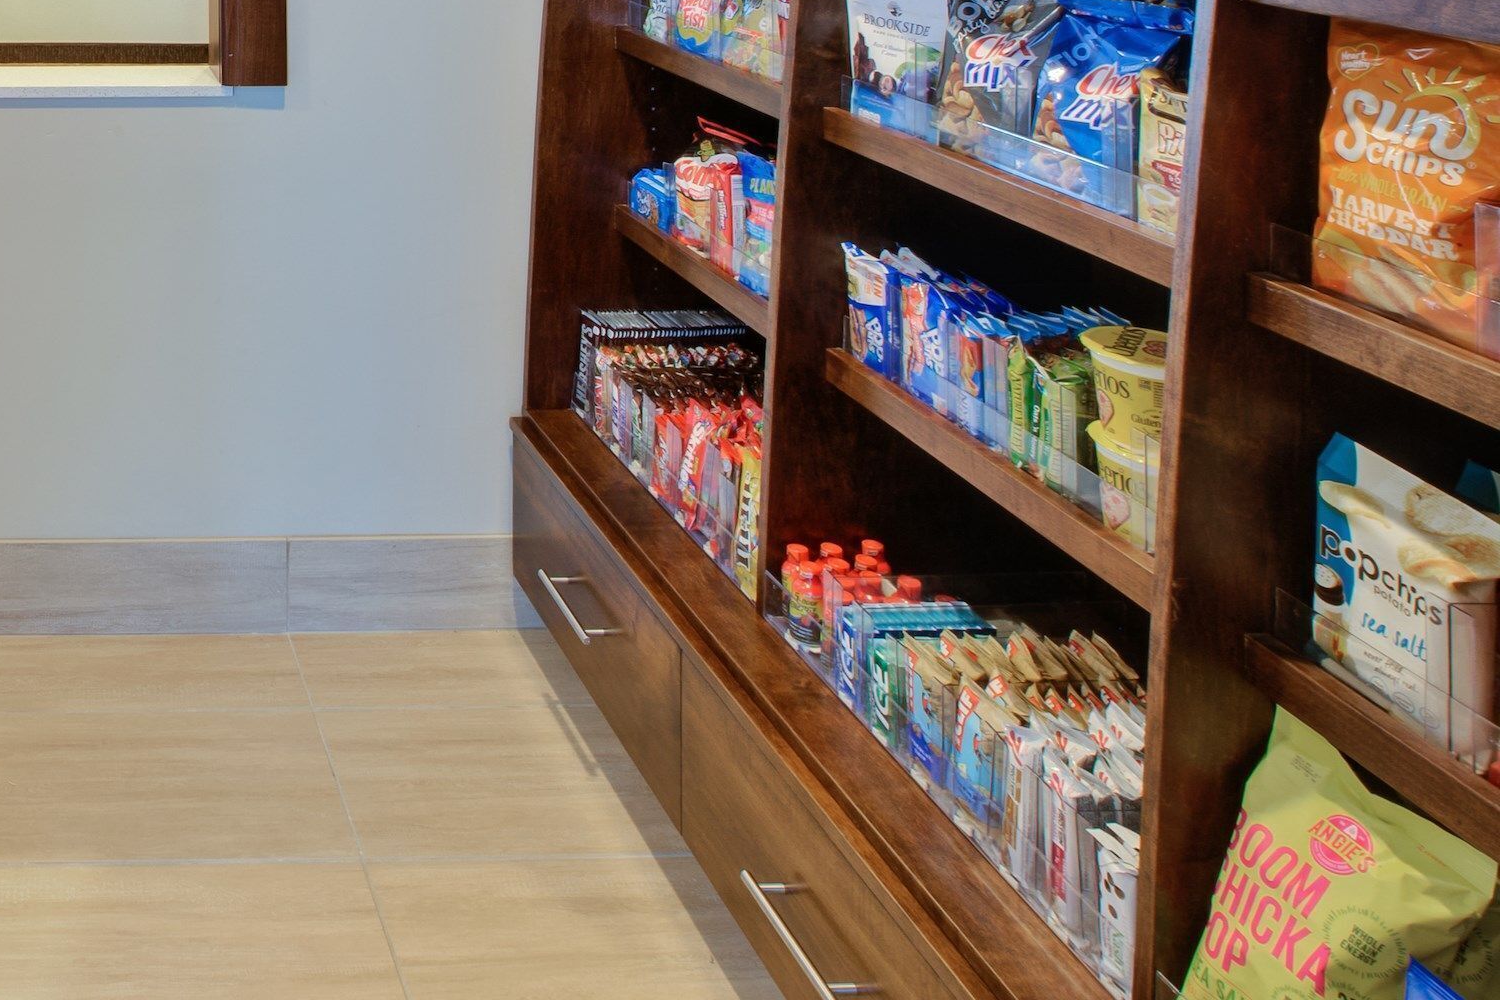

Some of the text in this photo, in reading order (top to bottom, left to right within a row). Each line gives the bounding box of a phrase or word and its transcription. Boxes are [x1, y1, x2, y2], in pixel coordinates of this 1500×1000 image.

[863, 13, 931, 37] BROOKSIDE
[966, 34, 1034, 60] Chex
[1079, 65, 1141, 96] Chex
[1366, 141, 1467, 187] CHIPS
[1326, 205, 1460, 262] CHEDDAR
[575, 323, 593, 402] HERSHEY'S
[1032, 404, 1040, 423] Oats
[1319, 523, 1444, 627] popchips
[1373, 585, 1412, 618] potato
[1361, 611, 1428, 664] sea salt
[1228, 807, 1332, 921] BOOM
[1308, 817, 1377, 874] ANGIE'S
[1204, 910, 1250, 974] OP
[1213, 853, 1332, 998] HICKA
[1347, 932, 1380, 958] GRAIN
[1351, 923, 1386, 952] WHOLE
[1339, 938, 1378, 967] ENERGY
